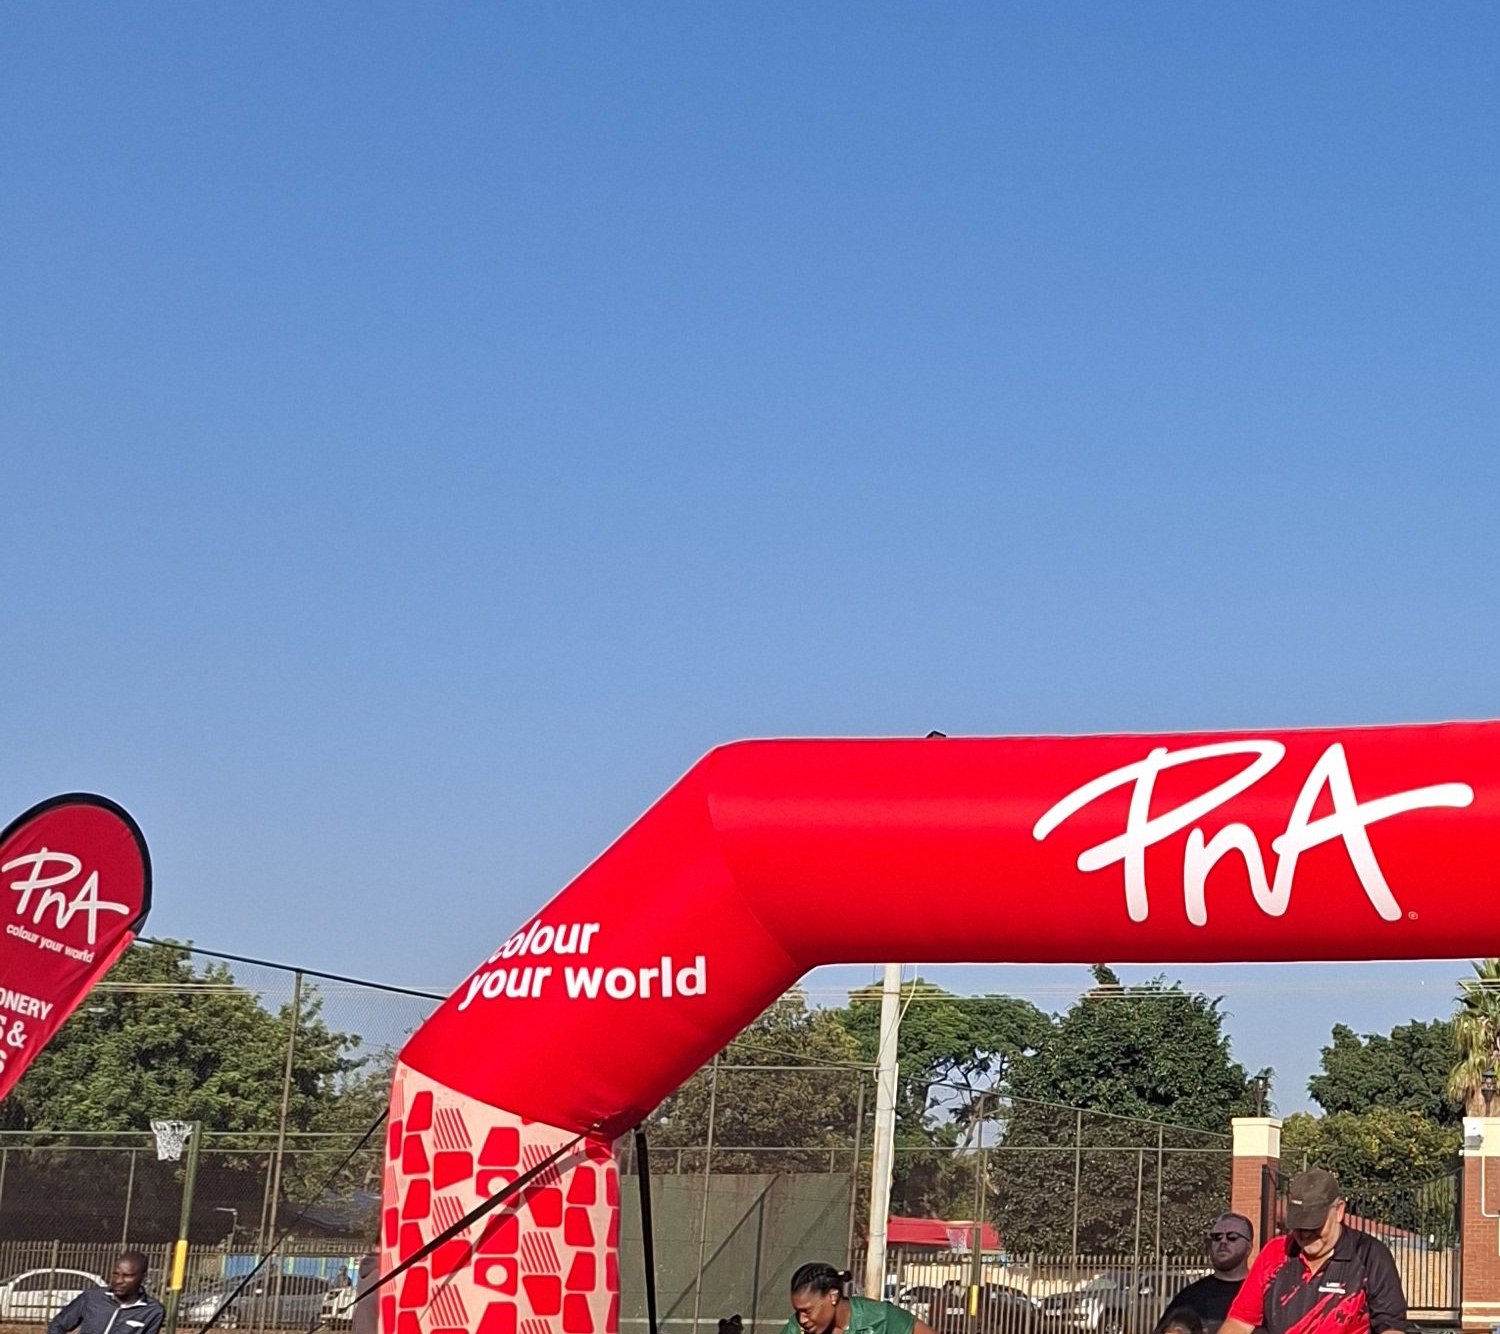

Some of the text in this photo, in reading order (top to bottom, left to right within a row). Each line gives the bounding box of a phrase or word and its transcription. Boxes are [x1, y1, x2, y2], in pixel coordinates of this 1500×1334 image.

[6, 924, 95, 964] colour your world
[457, 955, 707, 1012] your world
